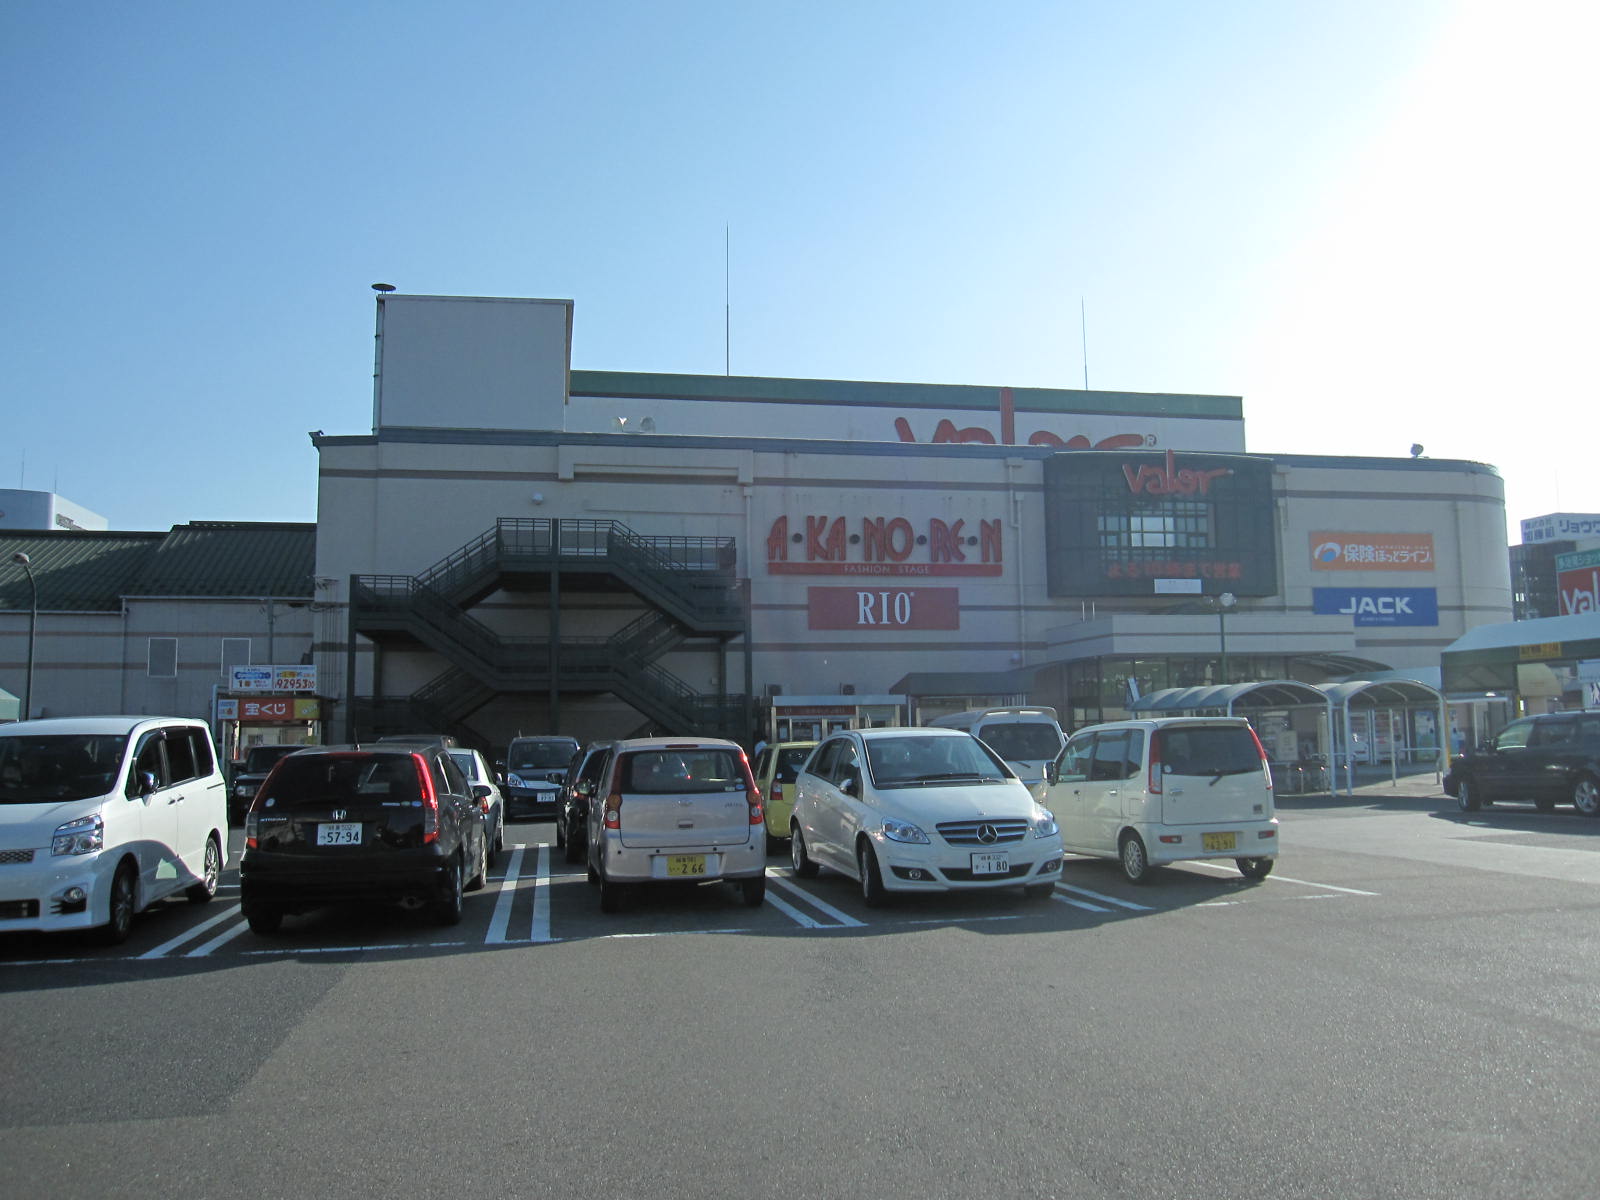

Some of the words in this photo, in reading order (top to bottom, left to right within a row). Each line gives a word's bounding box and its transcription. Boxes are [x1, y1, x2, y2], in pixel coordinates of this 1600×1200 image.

[844, 564, 890, 574] FASHION
[899, 565, 930, 574] STAGE
[857, 591, 911, 624] RIO
[1339, 597, 1413, 614] JACK
[245, 703, 286, 715] 宝くじ
[327, 831, 359, 843] 57-94
